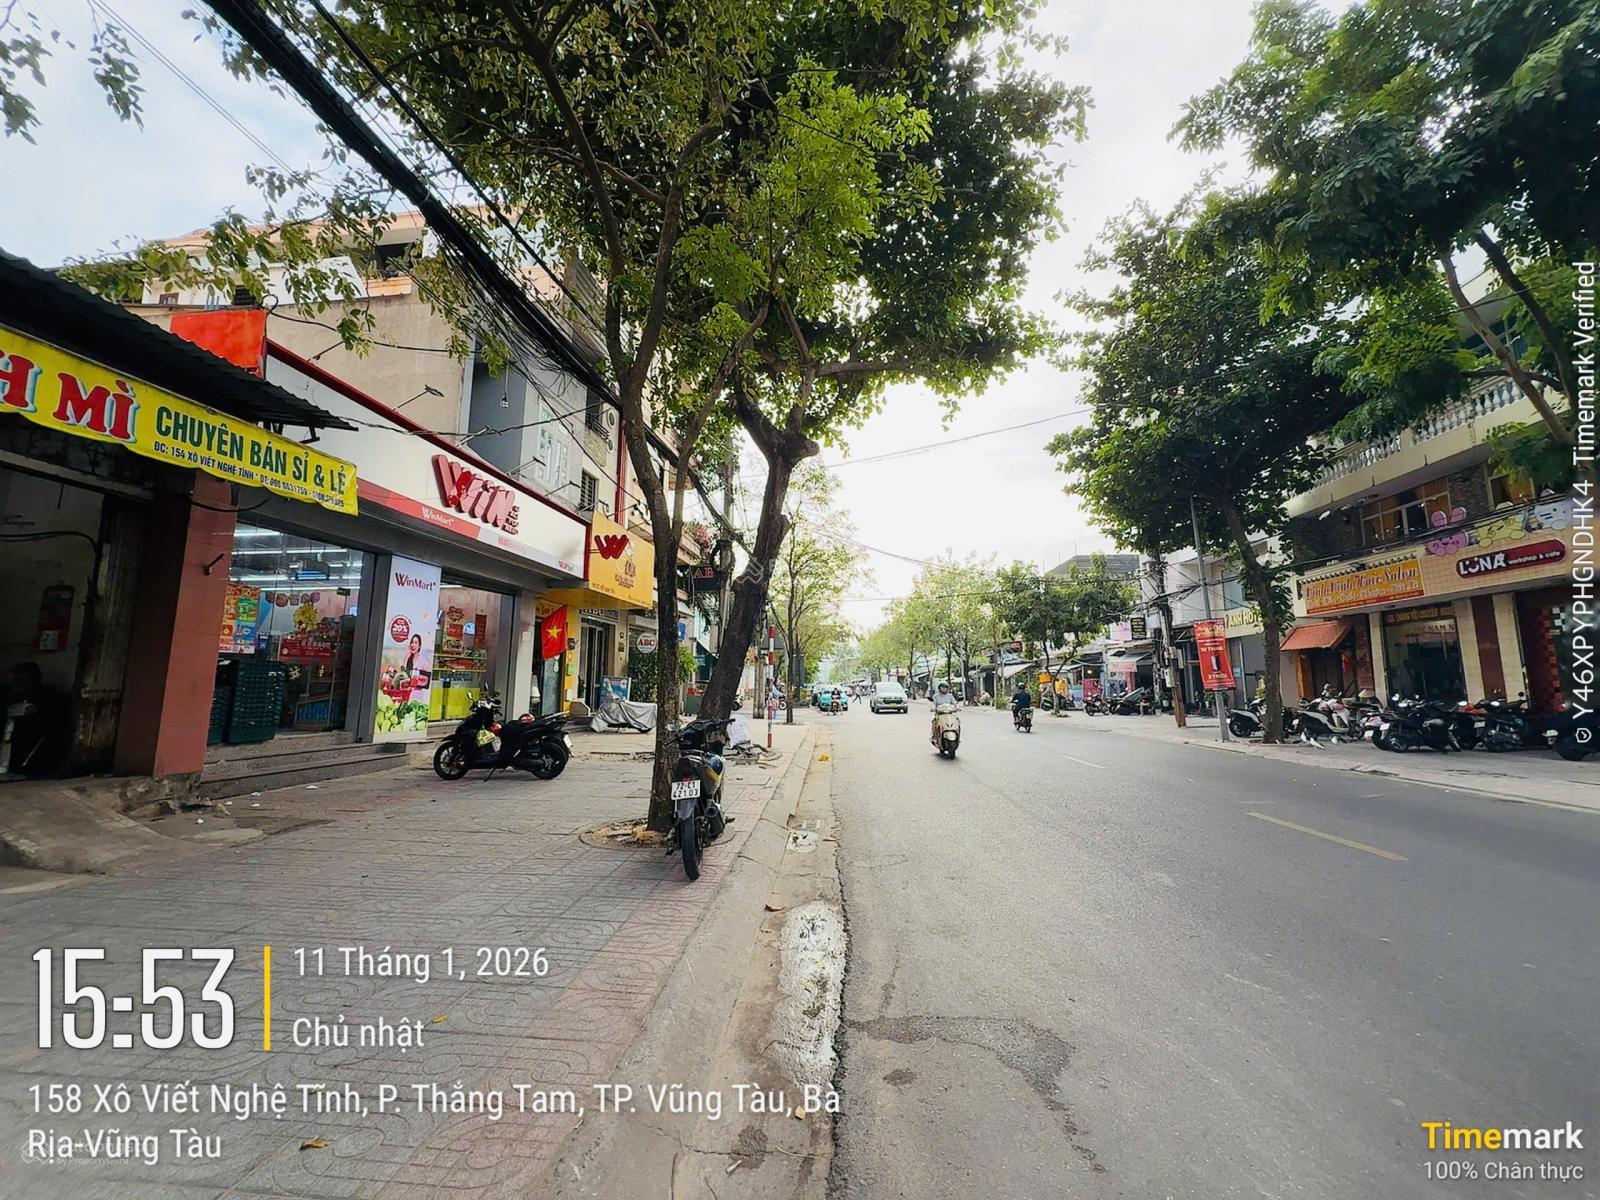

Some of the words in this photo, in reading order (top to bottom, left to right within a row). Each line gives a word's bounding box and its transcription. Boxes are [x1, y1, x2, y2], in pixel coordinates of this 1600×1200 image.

[53, 372, 138, 442] MÌ
[156, 405, 244, 462] CHUYÊN
[249, 440, 287, 476] BÁN
[292, 452, 309, 483] SỈ
[313, 464, 325, 488] &
[329, 465, 346, 495] LẺ
[172, 446, 186, 459] 154
[1460, 553, 1507, 575] LUNA
[638, 638, 656, 647] ABC
